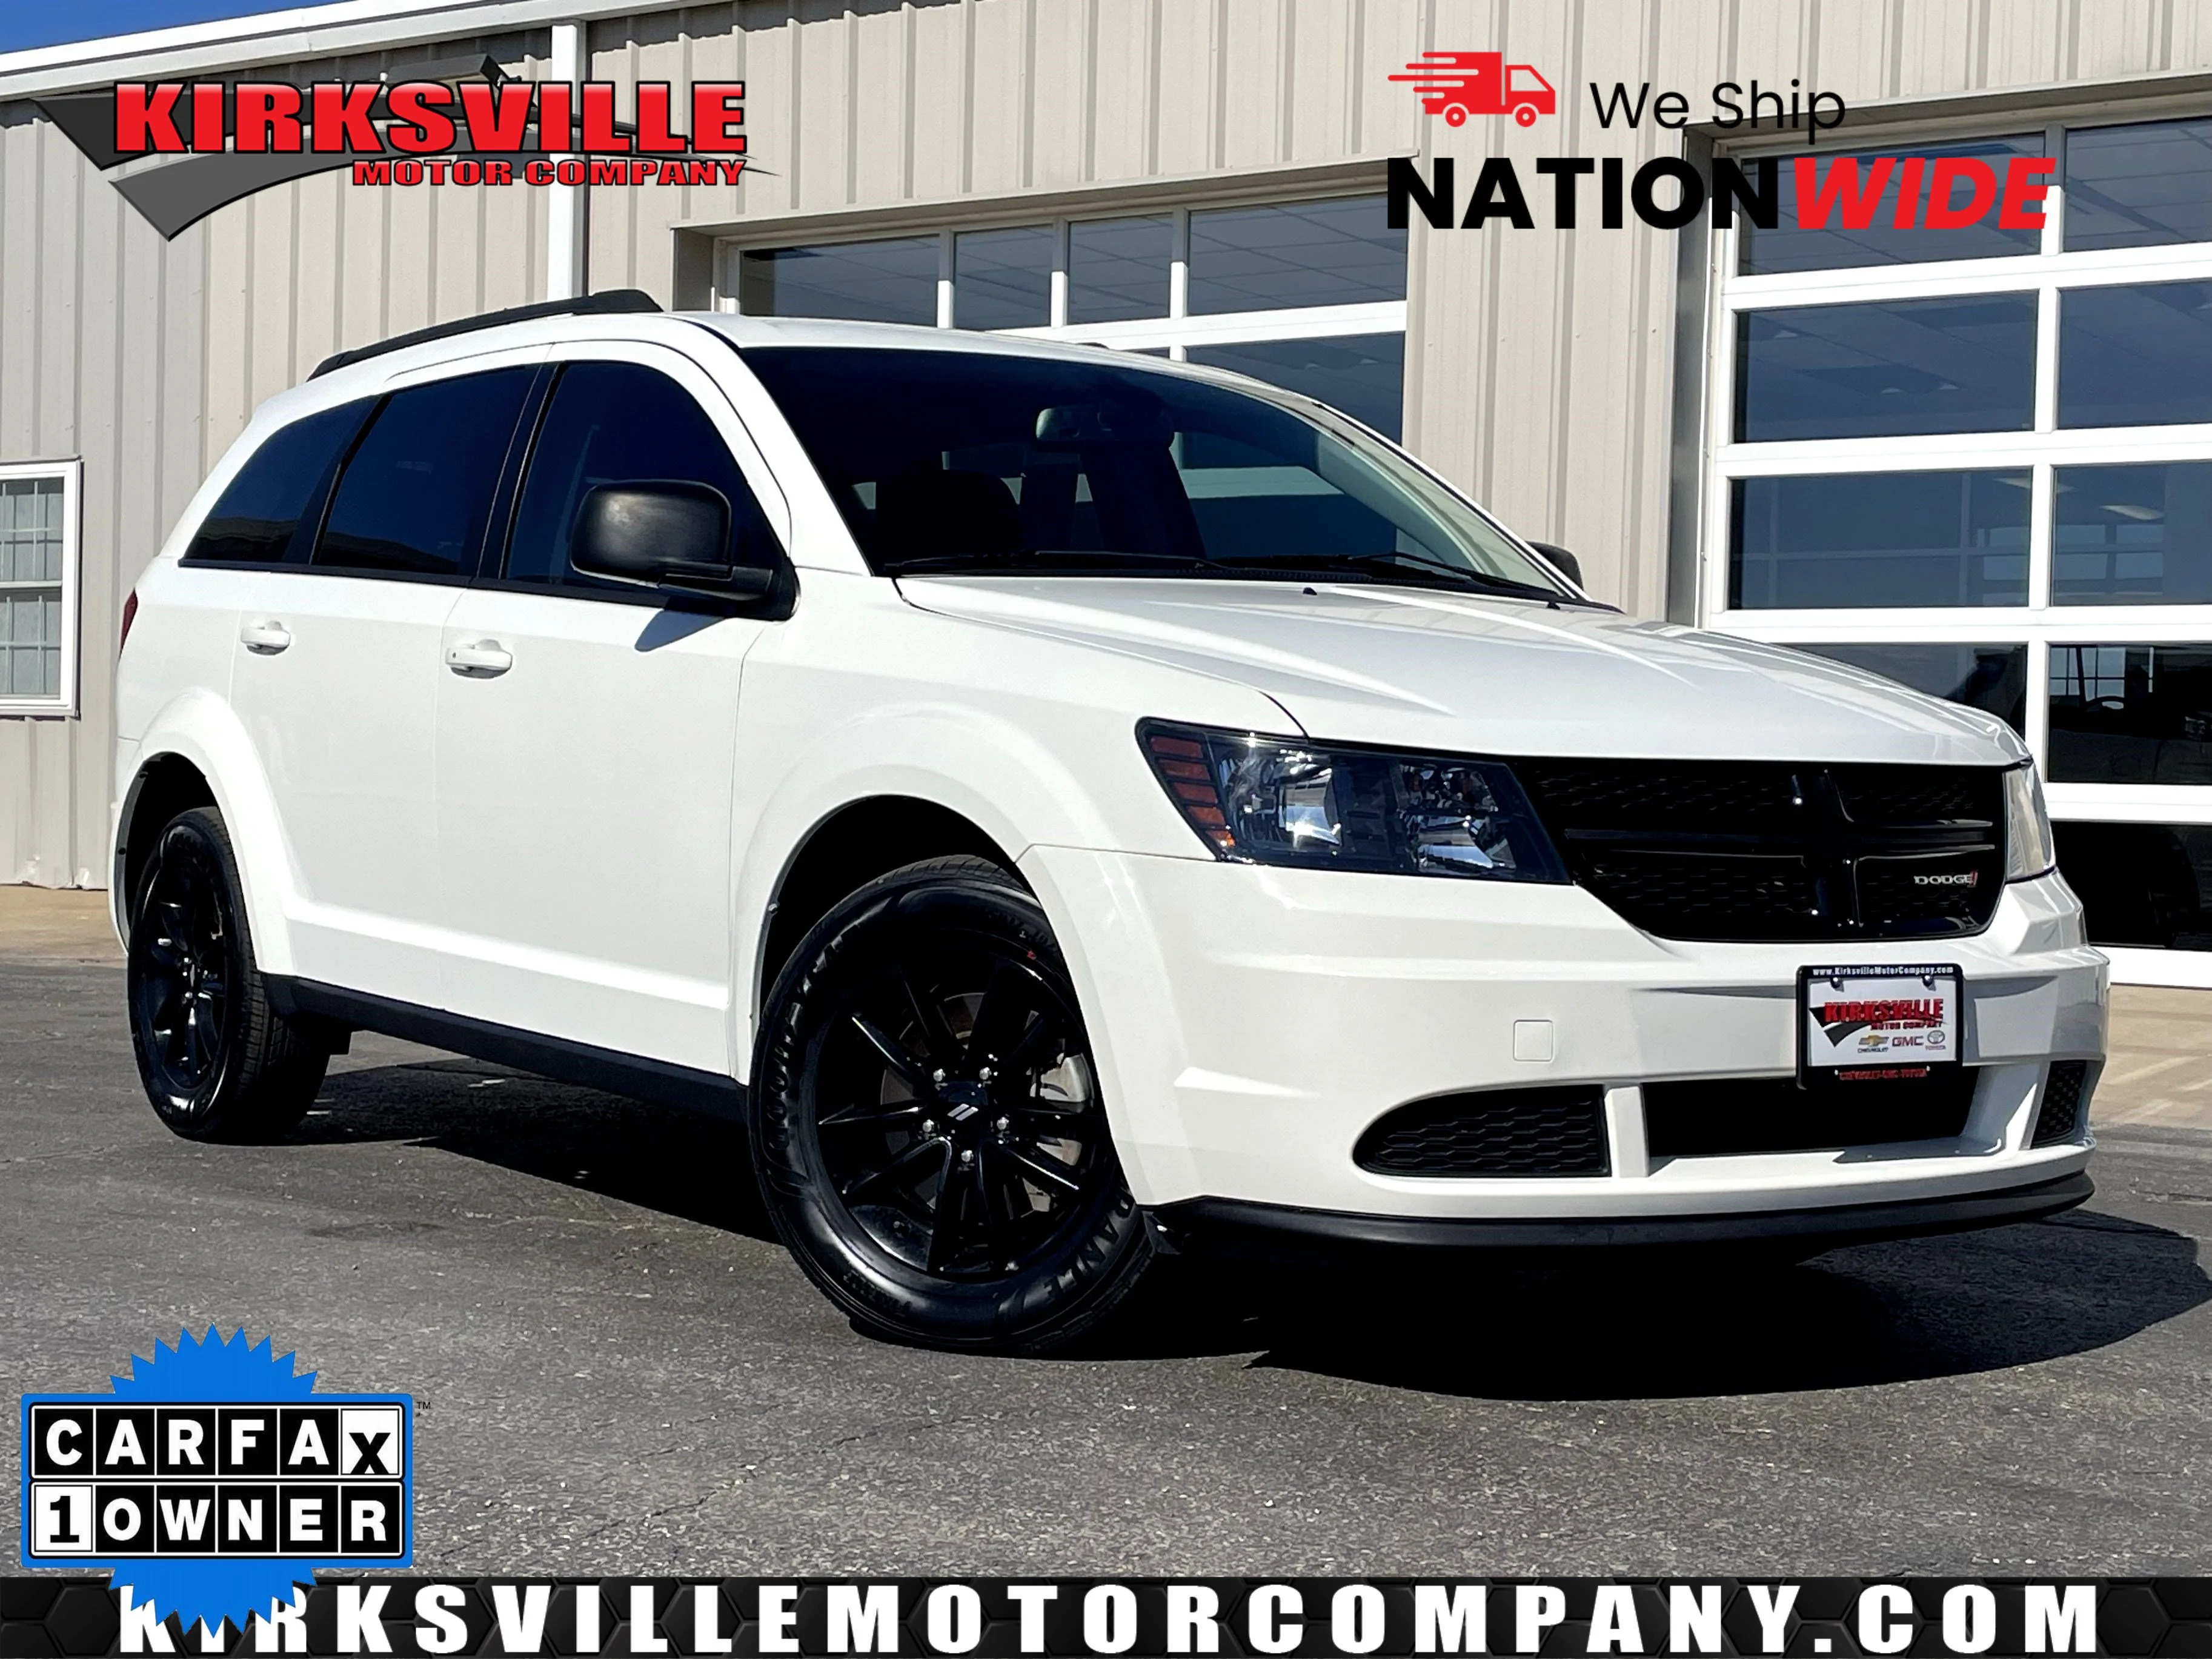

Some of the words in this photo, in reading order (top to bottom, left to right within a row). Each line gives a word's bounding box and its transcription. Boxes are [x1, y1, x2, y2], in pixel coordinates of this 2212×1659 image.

[1914, 875, 1973, 885] DODGE
[1825, 999, 1944, 1023] KIRKSVILLE
[1892, 1036, 1924, 1047] GMC
